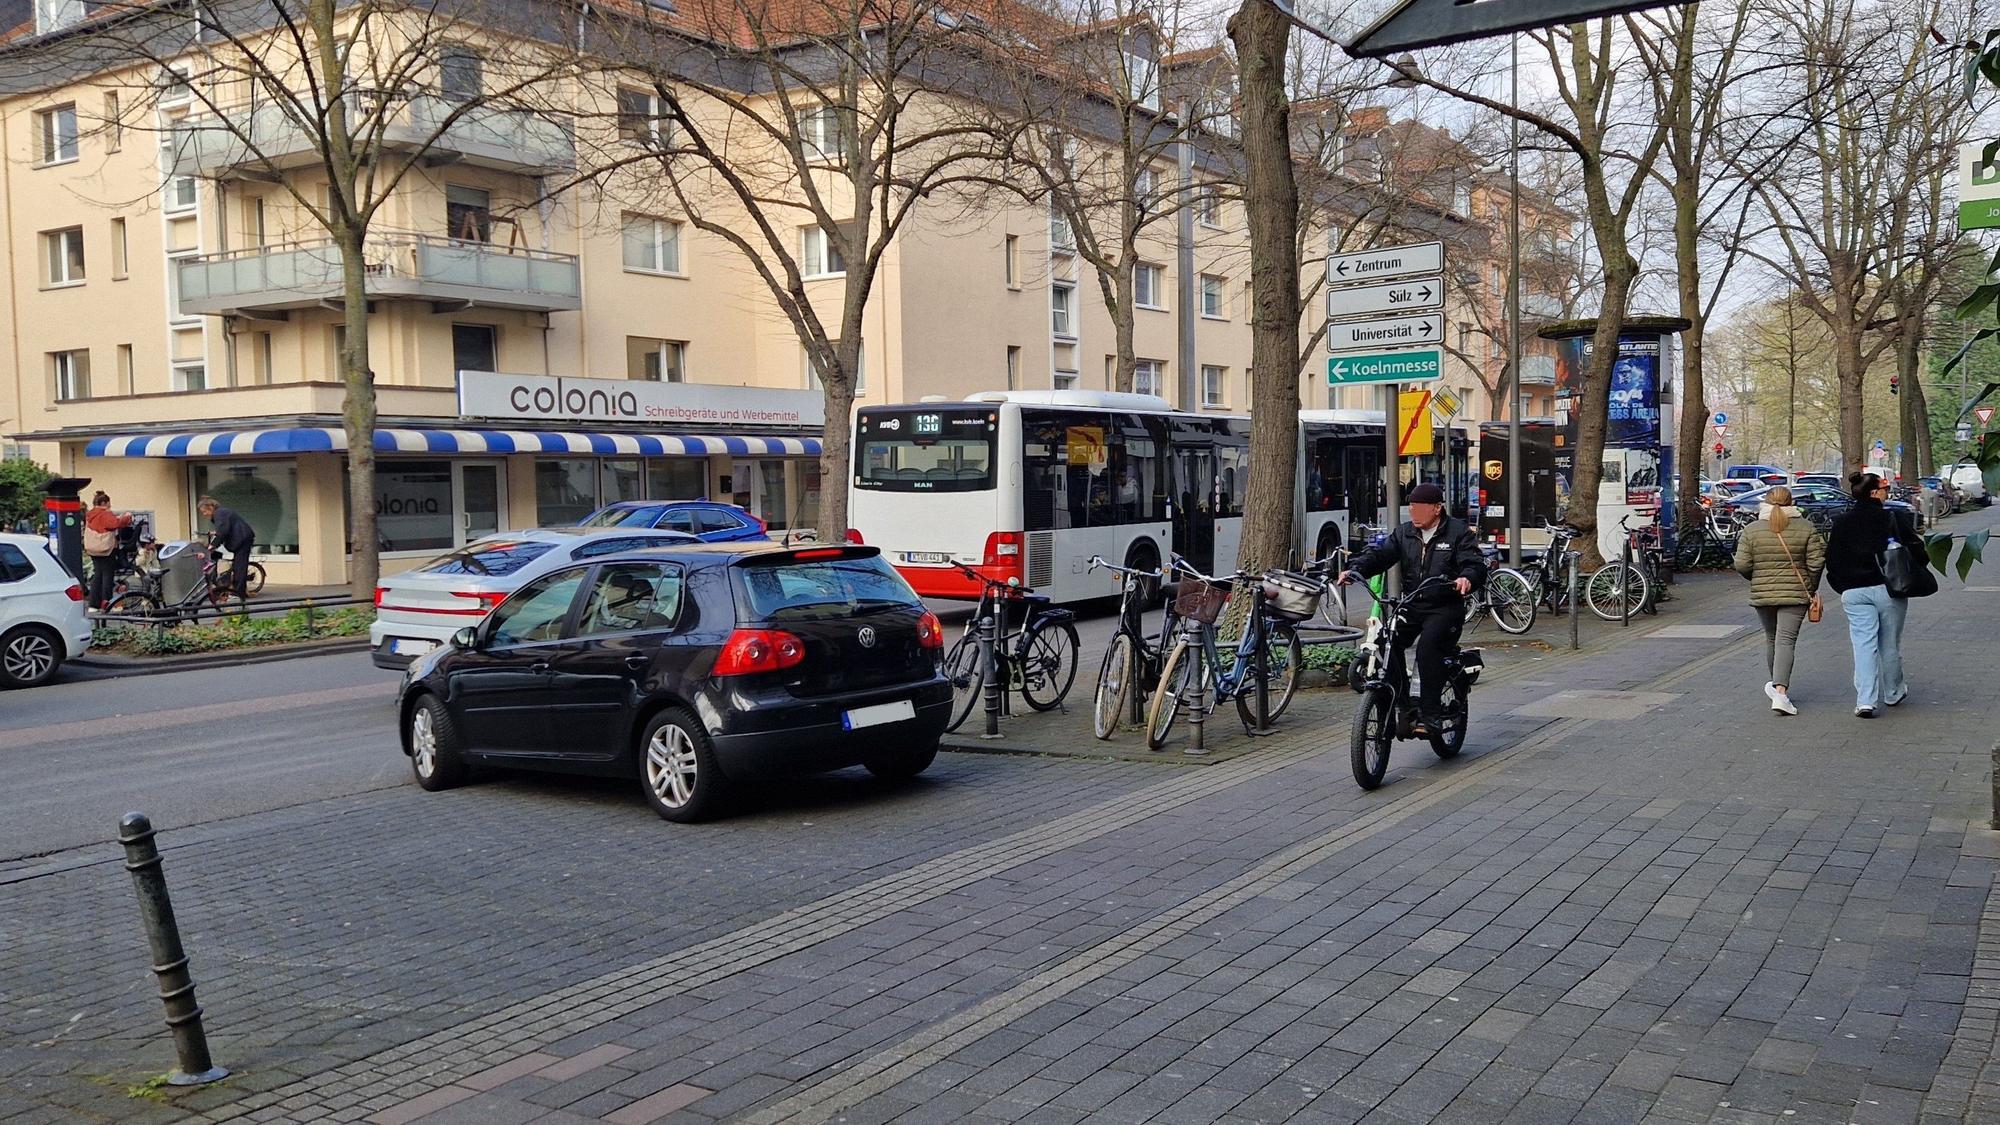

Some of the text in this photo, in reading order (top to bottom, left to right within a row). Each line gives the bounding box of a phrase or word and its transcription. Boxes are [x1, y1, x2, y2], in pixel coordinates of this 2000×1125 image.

[1355, 258, 1402, 273] Zentrum
[1388, 289, 1412, 303] Sülz
[1352, 324, 1412, 341] Universität
[1352, 360, 1437, 376] Koelnmesse
[510, 377, 638, 416] colonia
[644, 405, 799, 421] Schreibgeräte und Werbemittel
[1487, 466, 1502, 477] ups
